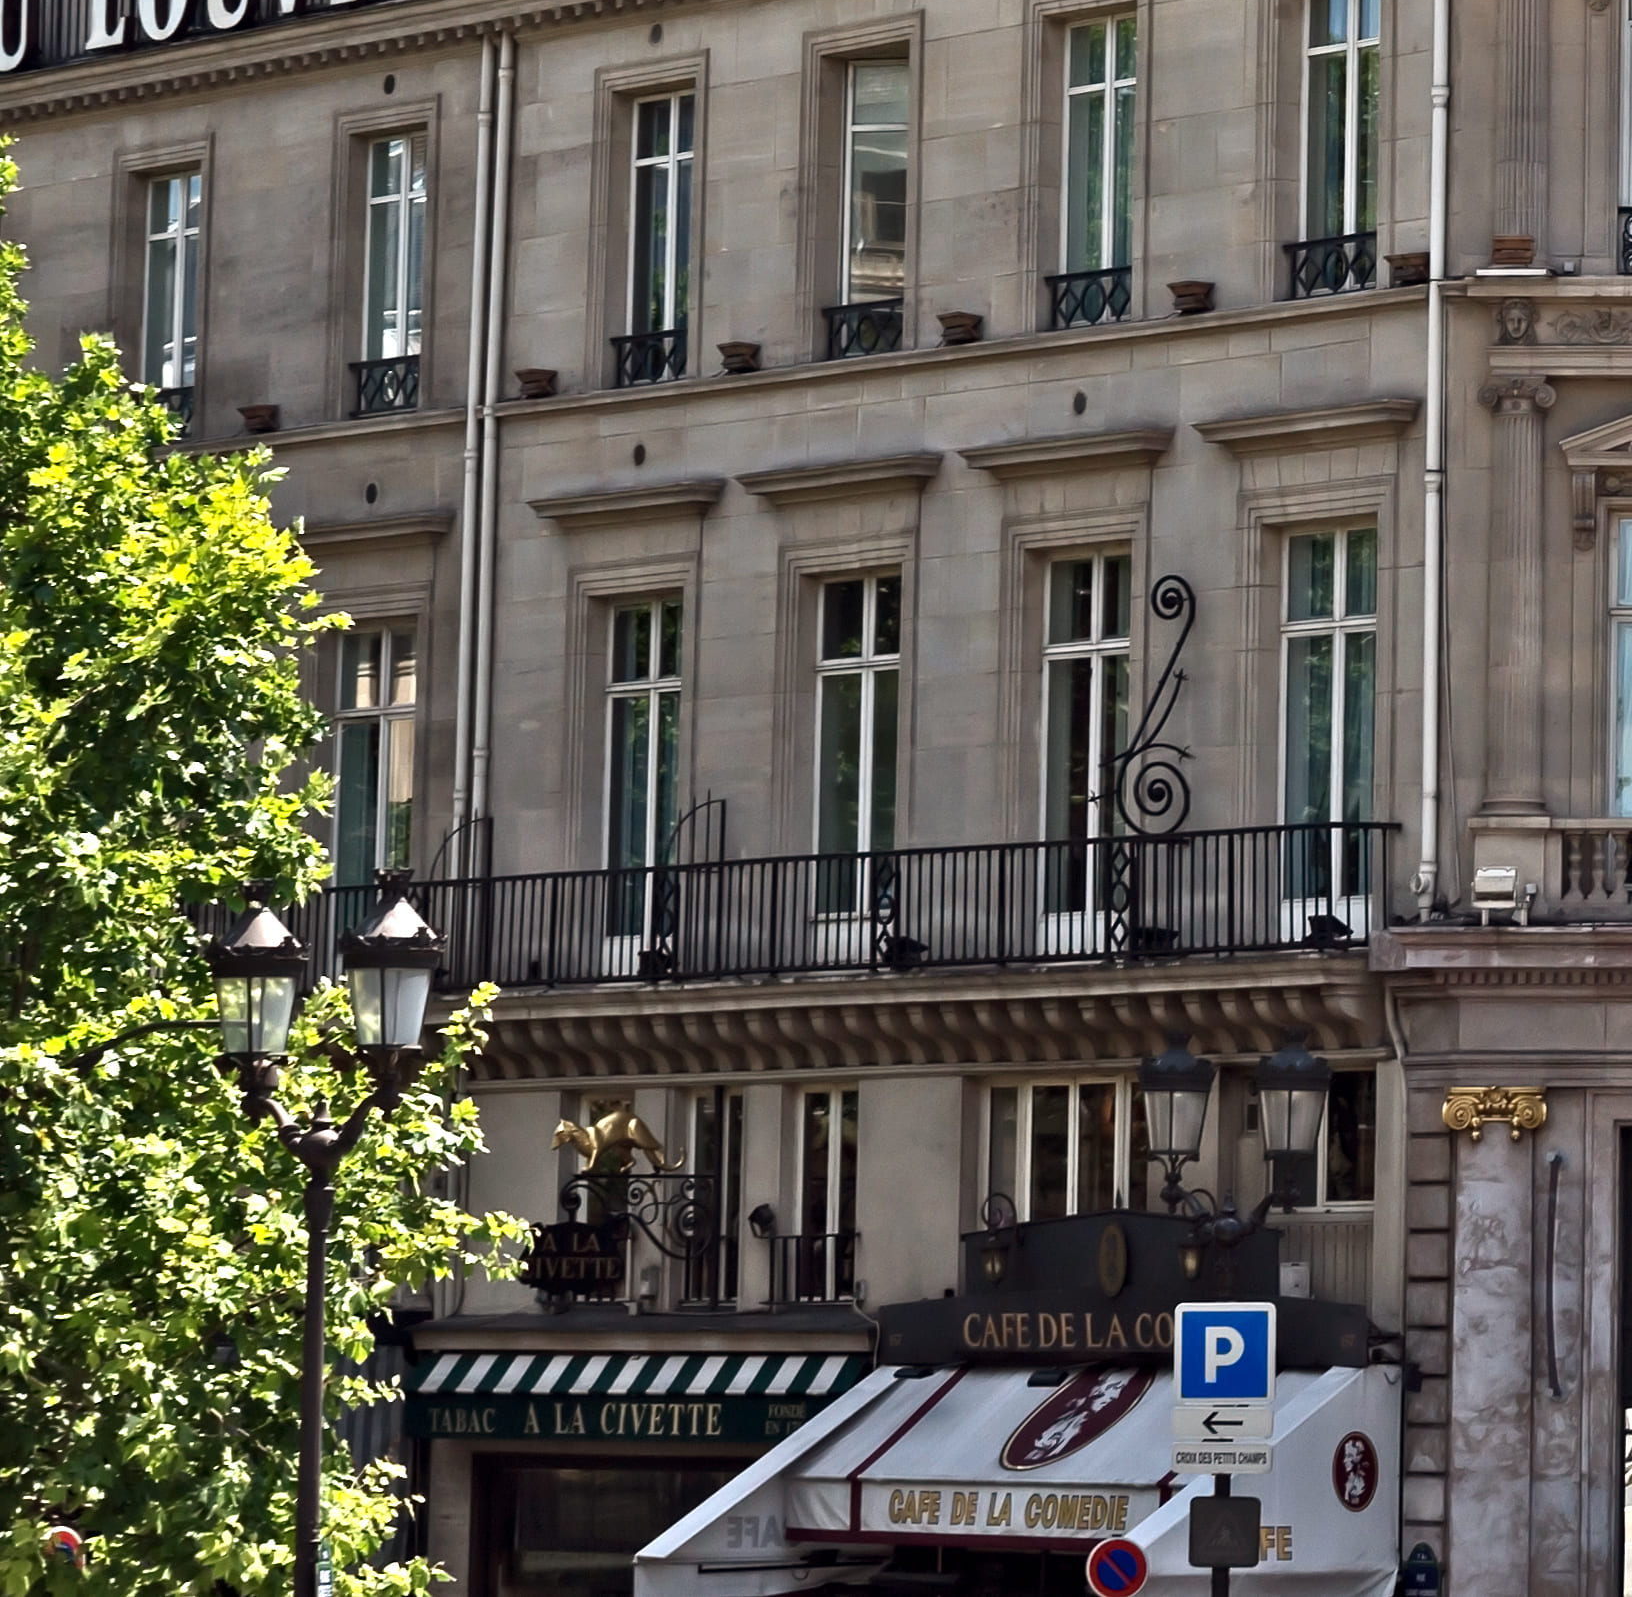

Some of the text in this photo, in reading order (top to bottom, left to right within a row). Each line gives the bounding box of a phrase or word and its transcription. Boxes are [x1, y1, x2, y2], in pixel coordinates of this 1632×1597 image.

[572, 1232, 600, 1252] LA
[963, 1313, 1174, 1347] CAFE DE LA CO
[1205, 1326, 1245, 1383] P
[430, 1402, 722, 1435] TABAC A LA CIVETTE
[1175, 1452, 1267, 1464] CROIX DES PETITS CHAMPS
[888, 1489, 1130, 1530] CAFE DE LA COMEDIE
[1260, 1525, 1293, 1561] FE
